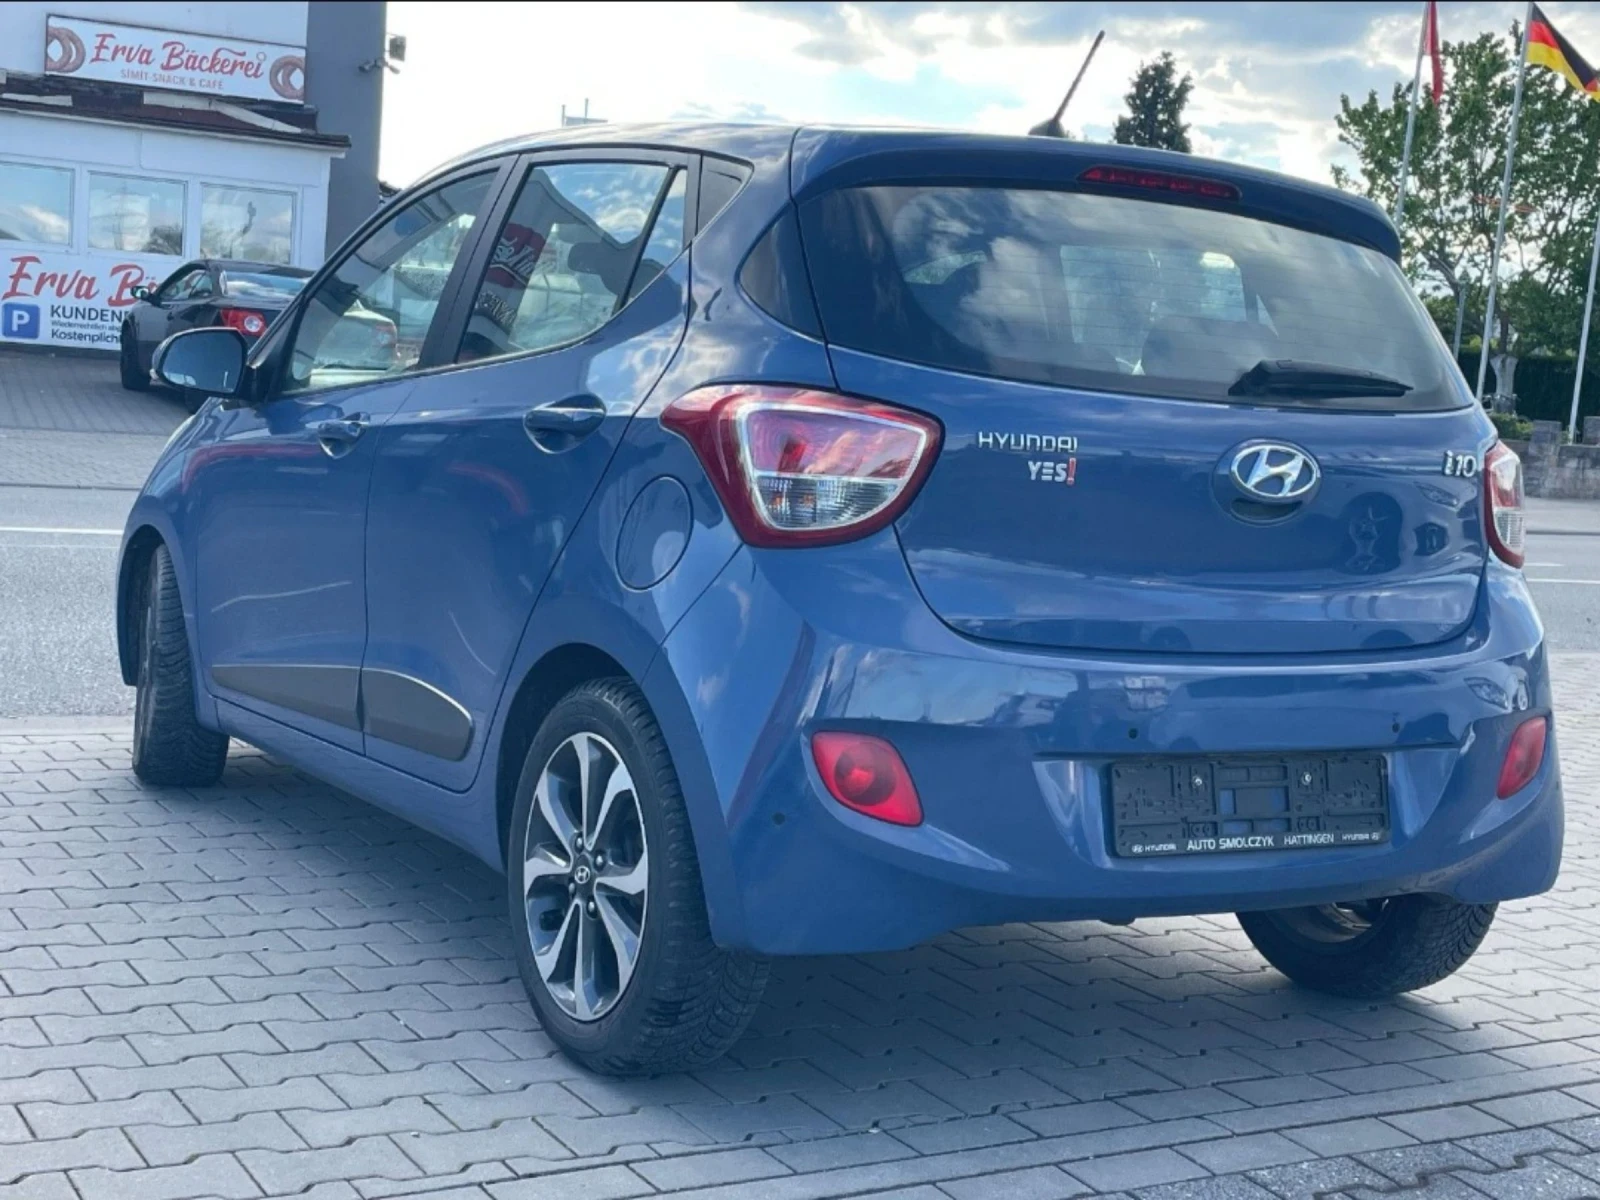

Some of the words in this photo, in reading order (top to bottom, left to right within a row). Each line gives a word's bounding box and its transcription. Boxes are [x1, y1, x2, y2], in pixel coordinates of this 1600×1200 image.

[89, 33, 155, 66] Erva
[160, 41, 267, 79] Bäckerei
[2, 255, 99, 301] Erva
[978, 431, 1078, 453] HYUNDAI
[1027, 457, 1076, 486] YES!
[1444, 449, 1477, 478] i10
[1186, 838, 1216, 851] AUTO
[1218, 835, 1275, 850] SMOLCZYK
[1283, 833, 1335, 845] HATTINGEN
